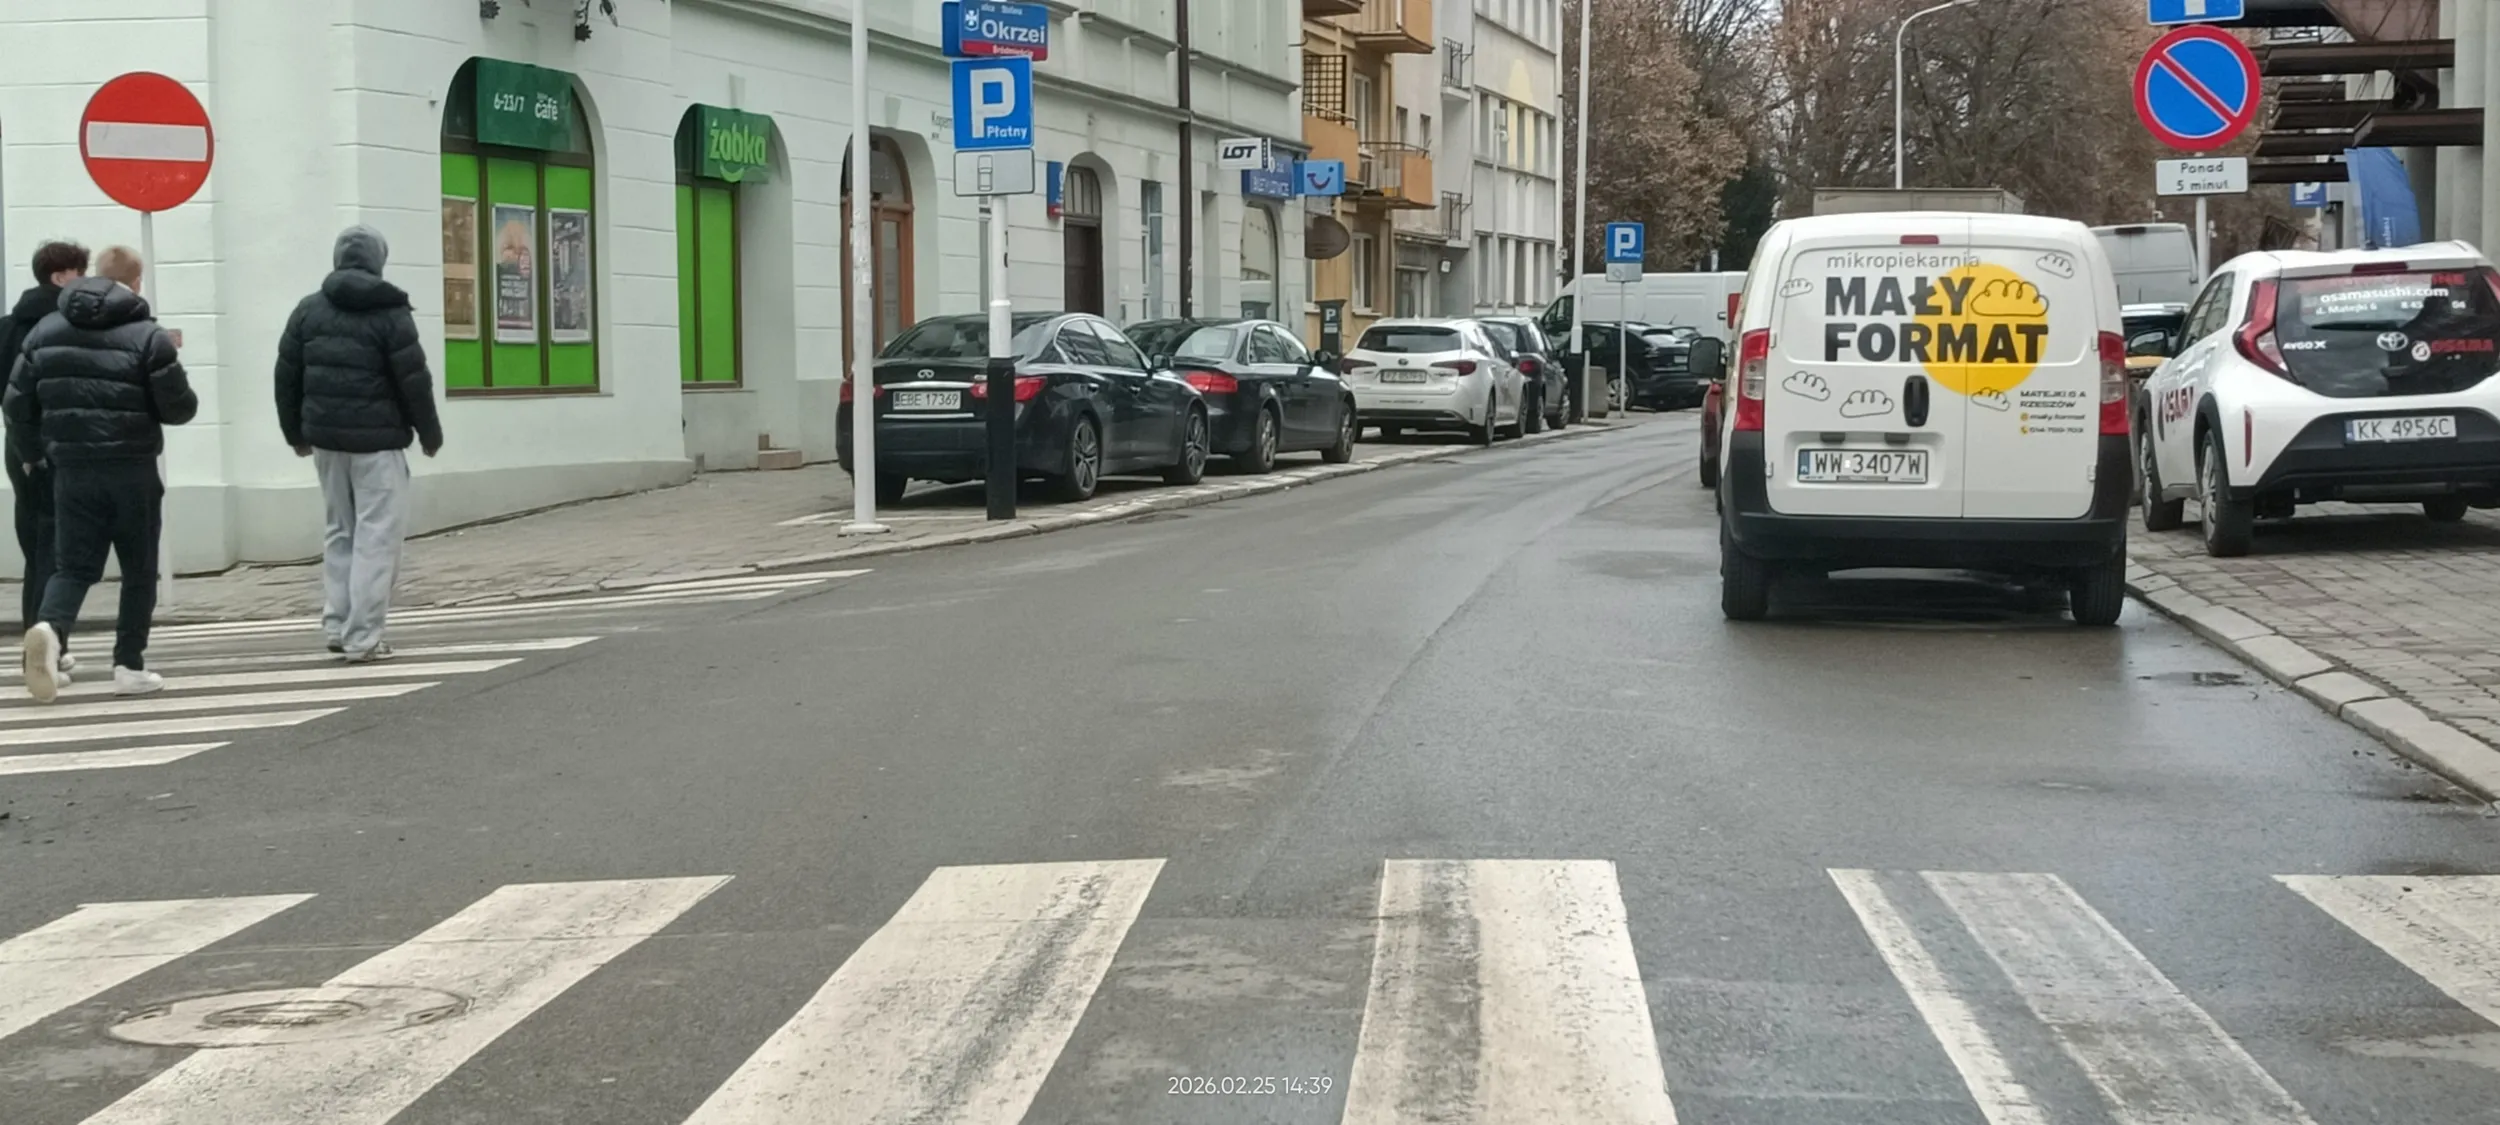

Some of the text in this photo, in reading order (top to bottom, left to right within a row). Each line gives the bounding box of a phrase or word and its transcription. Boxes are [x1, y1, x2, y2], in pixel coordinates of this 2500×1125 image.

[981, 19, 1045, 44] Okrzei
[494, 92, 525, 113] 6-23/7
[970, 68, 1015, 138] P
[709, 118, 766, 165] żabka
[986, 125, 1028, 140] Płatny
[1223, 145, 1257, 159] LOT
[2180, 160, 2224, 173] Ponad
[2176, 179, 2229, 191] 5 minut
[1614, 227, 1636, 257] P
[1826, 252, 1979, 272] mikropiekarnia
[1825, 277, 1975, 316] MAŁY
[2320, 286, 2449, 303] osamasushi.com
[1326, 308, 1337, 321] P
[1825, 322, 2048, 363] FORMAT
[900, 393, 959, 406] EBE 17369
[2020, 400, 2076, 408] RZESZÓW
[2358, 418, 2449, 439] KK 4956C
[1815, 453, 1921, 475] WW 3407W
